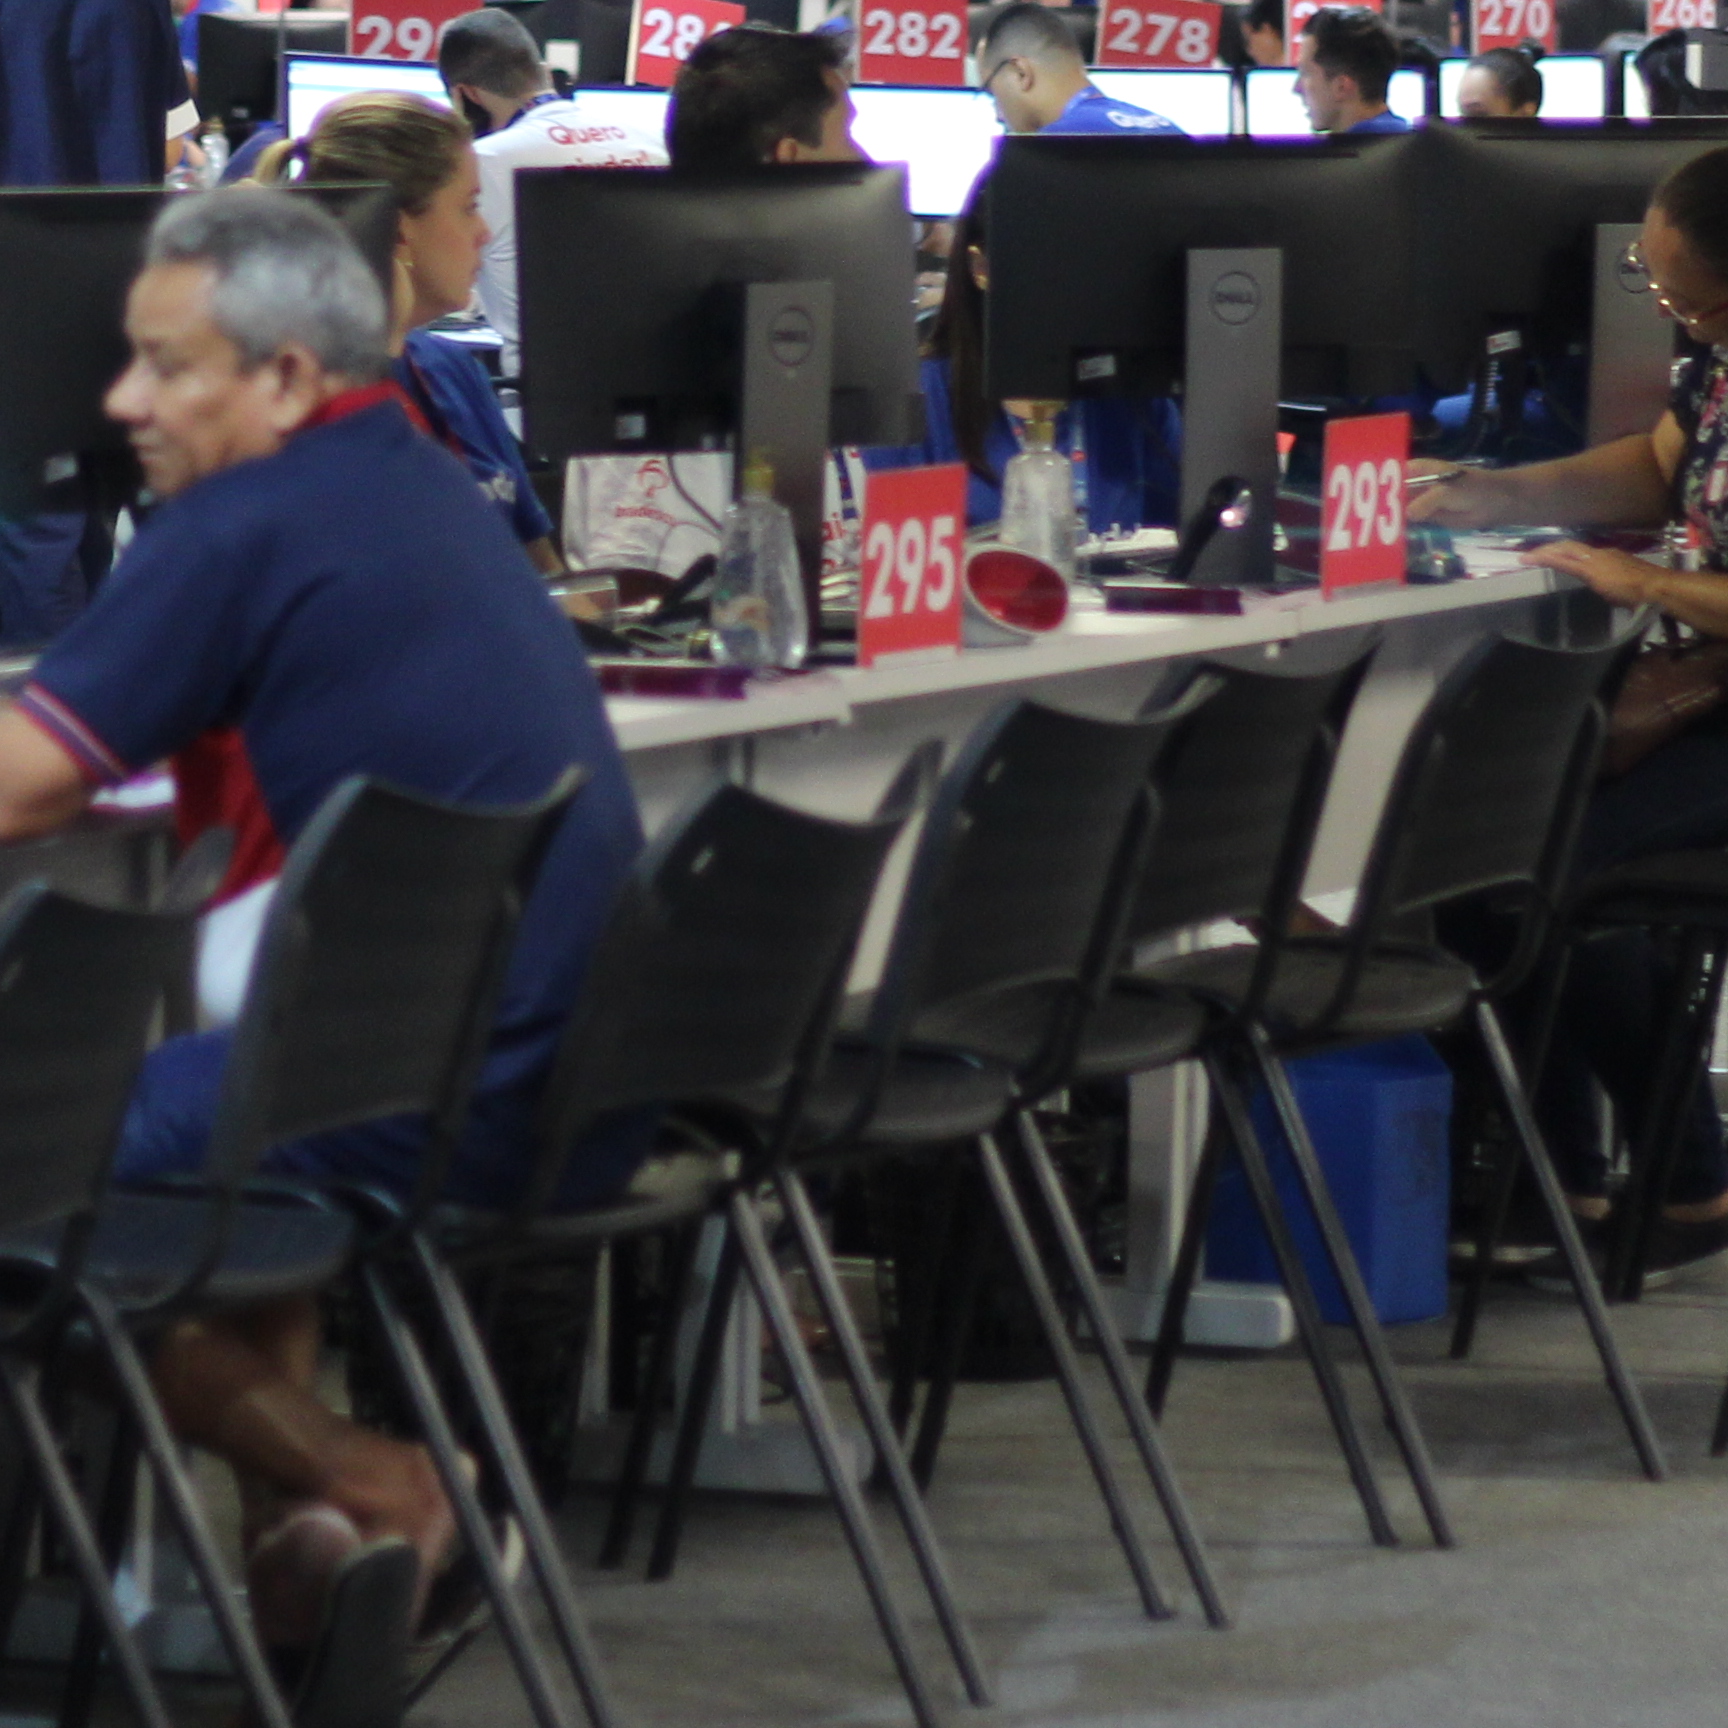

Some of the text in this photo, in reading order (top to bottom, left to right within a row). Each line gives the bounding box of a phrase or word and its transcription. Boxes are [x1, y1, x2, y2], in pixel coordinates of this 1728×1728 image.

[356, 15, 450, 63] 29
[640, 7, 734, 61] 28
[863, 9, 962, 59] 282
[1106, 8, 1211, 63] 278
[547, 126, 625, 145] Quero
[1326, 458, 1402, 552] 293
[865, 515, 956, 620] 295
